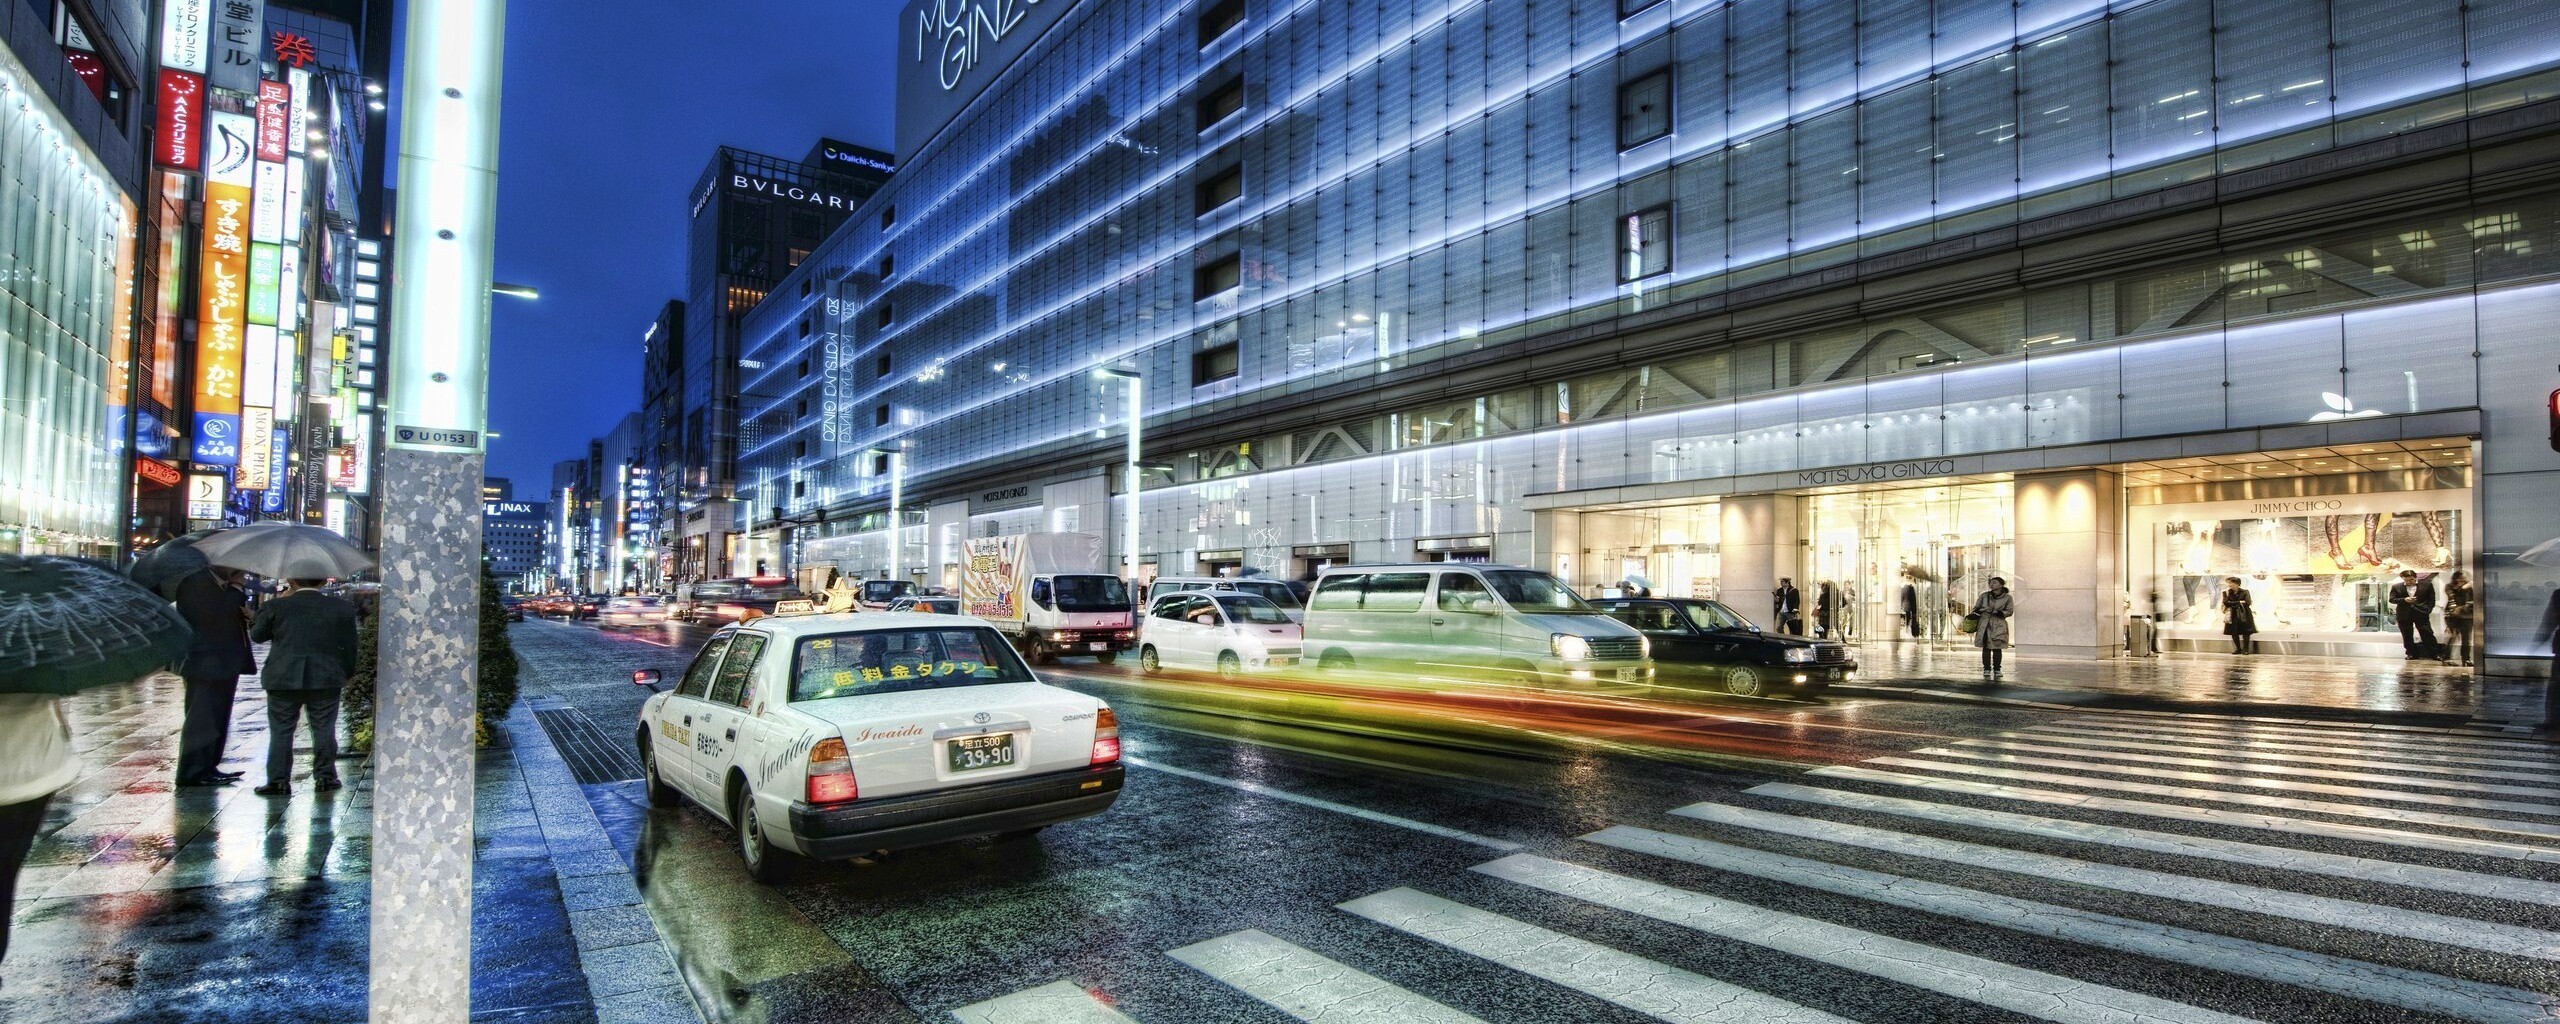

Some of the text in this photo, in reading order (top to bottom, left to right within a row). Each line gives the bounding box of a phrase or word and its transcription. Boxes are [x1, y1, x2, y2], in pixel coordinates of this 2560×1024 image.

[941, 0, 1039, 90] GINZ
[733, 174, 854, 211] BVLGARI
[252, 411, 267, 488] MOON PHASE
[433, 432, 465, 443] 0153
[267, 436, 284, 507] CHAUMET
[2250, 500, 2342, 514] JIMMY CHOO
[812, 639, 833, 650] 22
[832, 660, 998, 687] 低料金タクシー
[678, 726, 690, 747] TAXI
[857, 724, 924, 742] Iwaida
[757, 727, 815, 790] Iwaida
[963, 746, 1012, 768] 39-90
